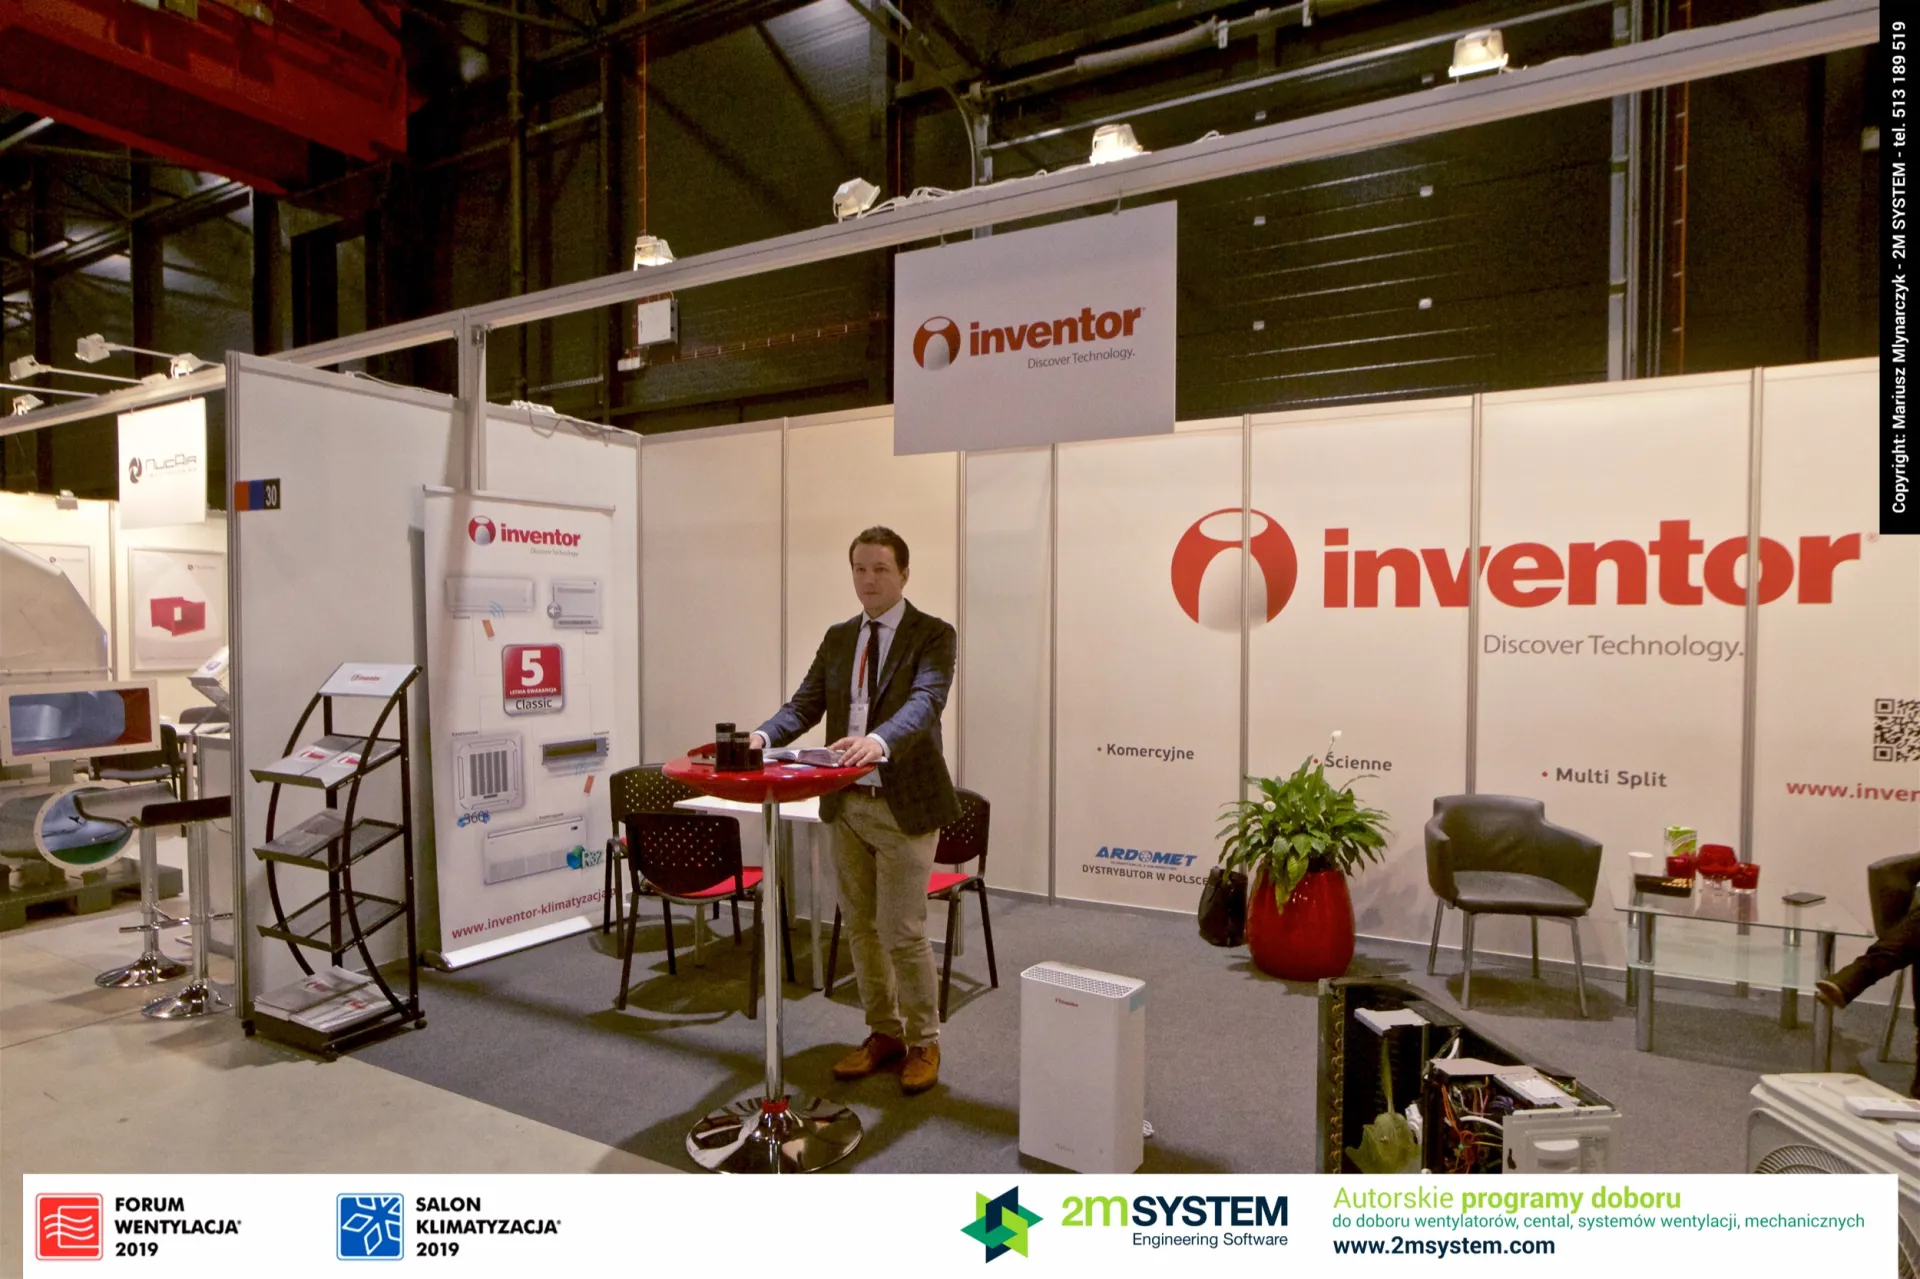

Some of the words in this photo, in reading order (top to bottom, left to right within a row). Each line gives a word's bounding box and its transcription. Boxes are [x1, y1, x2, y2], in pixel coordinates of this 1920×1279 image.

[969, 306, 1142, 357] inventor
[1027, 355, 1071, 369] Discover
[1073, 348, 1136, 364] Technology.
[265, 485, 278, 506] 30
[500, 523, 582, 547] inventor
[1323, 518, 1862, 609] inventor
[1484, 634, 1584, 655] Discover
[1588, 634, 1745, 662] Technology.
[520, 649, 544, 687] 5
[515, 697, 552, 711] Classic
[1106, 744, 1195, 762] Komercyjne
[1324, 751, 1393, 772] Ścienne
[1556, 767, 1609, 785] Multi
[1617, 770, 1668, 789] Split
[1095, 846, 1198, 867] ARDOMET
[1081, 864, 1153, 880] DYSTRYBUTOR
[1156, 873, 1166, 881] W
[1168, 873, 1209, 886] POLSCE
